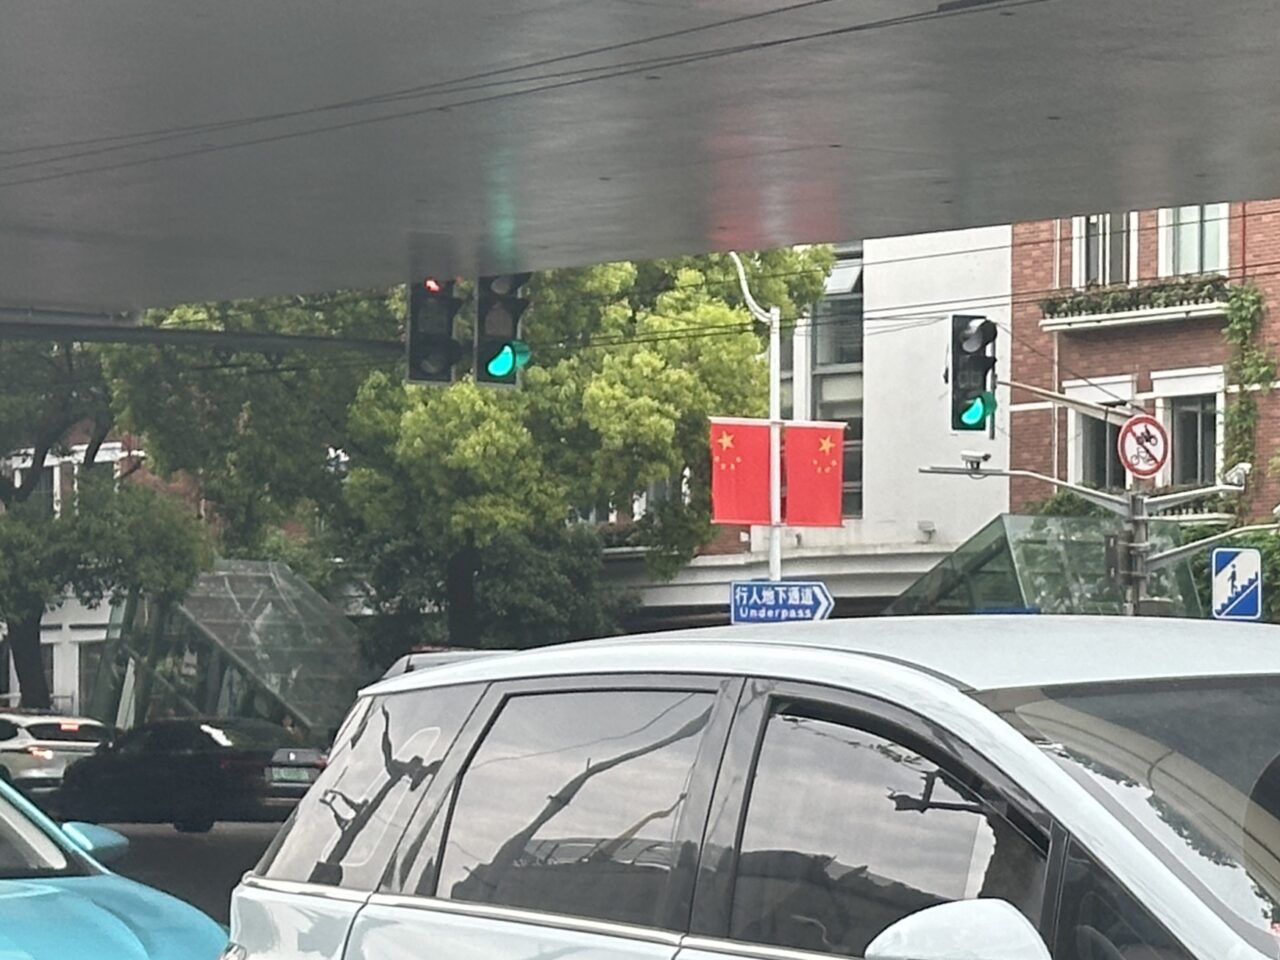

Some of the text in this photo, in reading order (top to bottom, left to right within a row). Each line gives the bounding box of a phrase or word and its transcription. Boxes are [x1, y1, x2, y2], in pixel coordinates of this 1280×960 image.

[735, 586, 814, 605] 行人地下通道
[740, 607, 812, 620] Underpass
